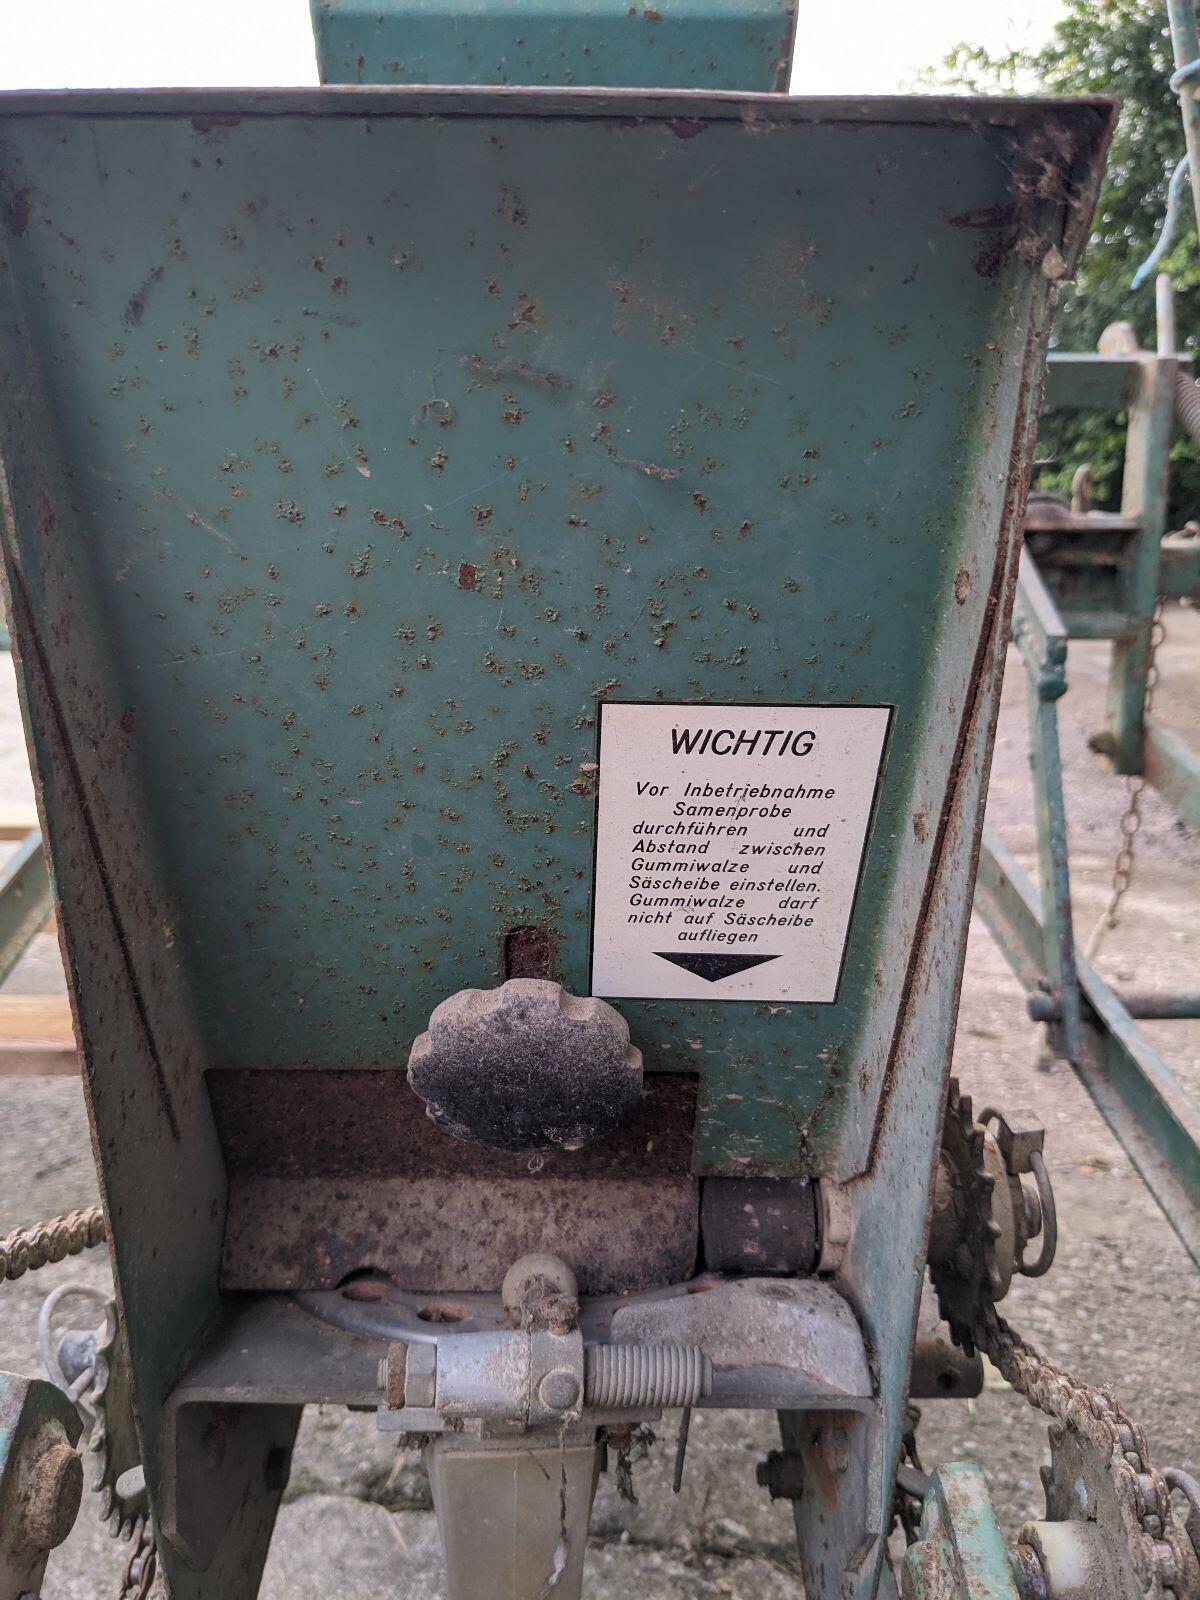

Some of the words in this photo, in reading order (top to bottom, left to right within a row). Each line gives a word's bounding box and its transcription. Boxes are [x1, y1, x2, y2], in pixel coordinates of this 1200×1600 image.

[671, 728, 817, 757] WICHTIG
[636, 781, 670, 797] Vor
[683, 782, 836, 800] Inbetriebnahme
[672, 801, 792, 821] Samenprobe
[632, 820, 748, 837] durchführen
[793, 823, 831, 838] und
[631, 838, 711, 855] Abstand
[738, 841, 826, 857] zwischen
[631, 857, 750, 874] Gummiwalze
[787, 860, 824, 875] und
[628, 875, 721, 891] Säscheibe
[729, 878, 822, 893] einstellen.
[629, 892, 746, 909] Gummiwalze
[778, 895, 821, 910] darf
[627, 910, 674, 925] nicht
[683, 911, 717, 926] auf
[723, 912, 814, 928] Säscheibe
[677, 928, 759, 945] aufliegen
